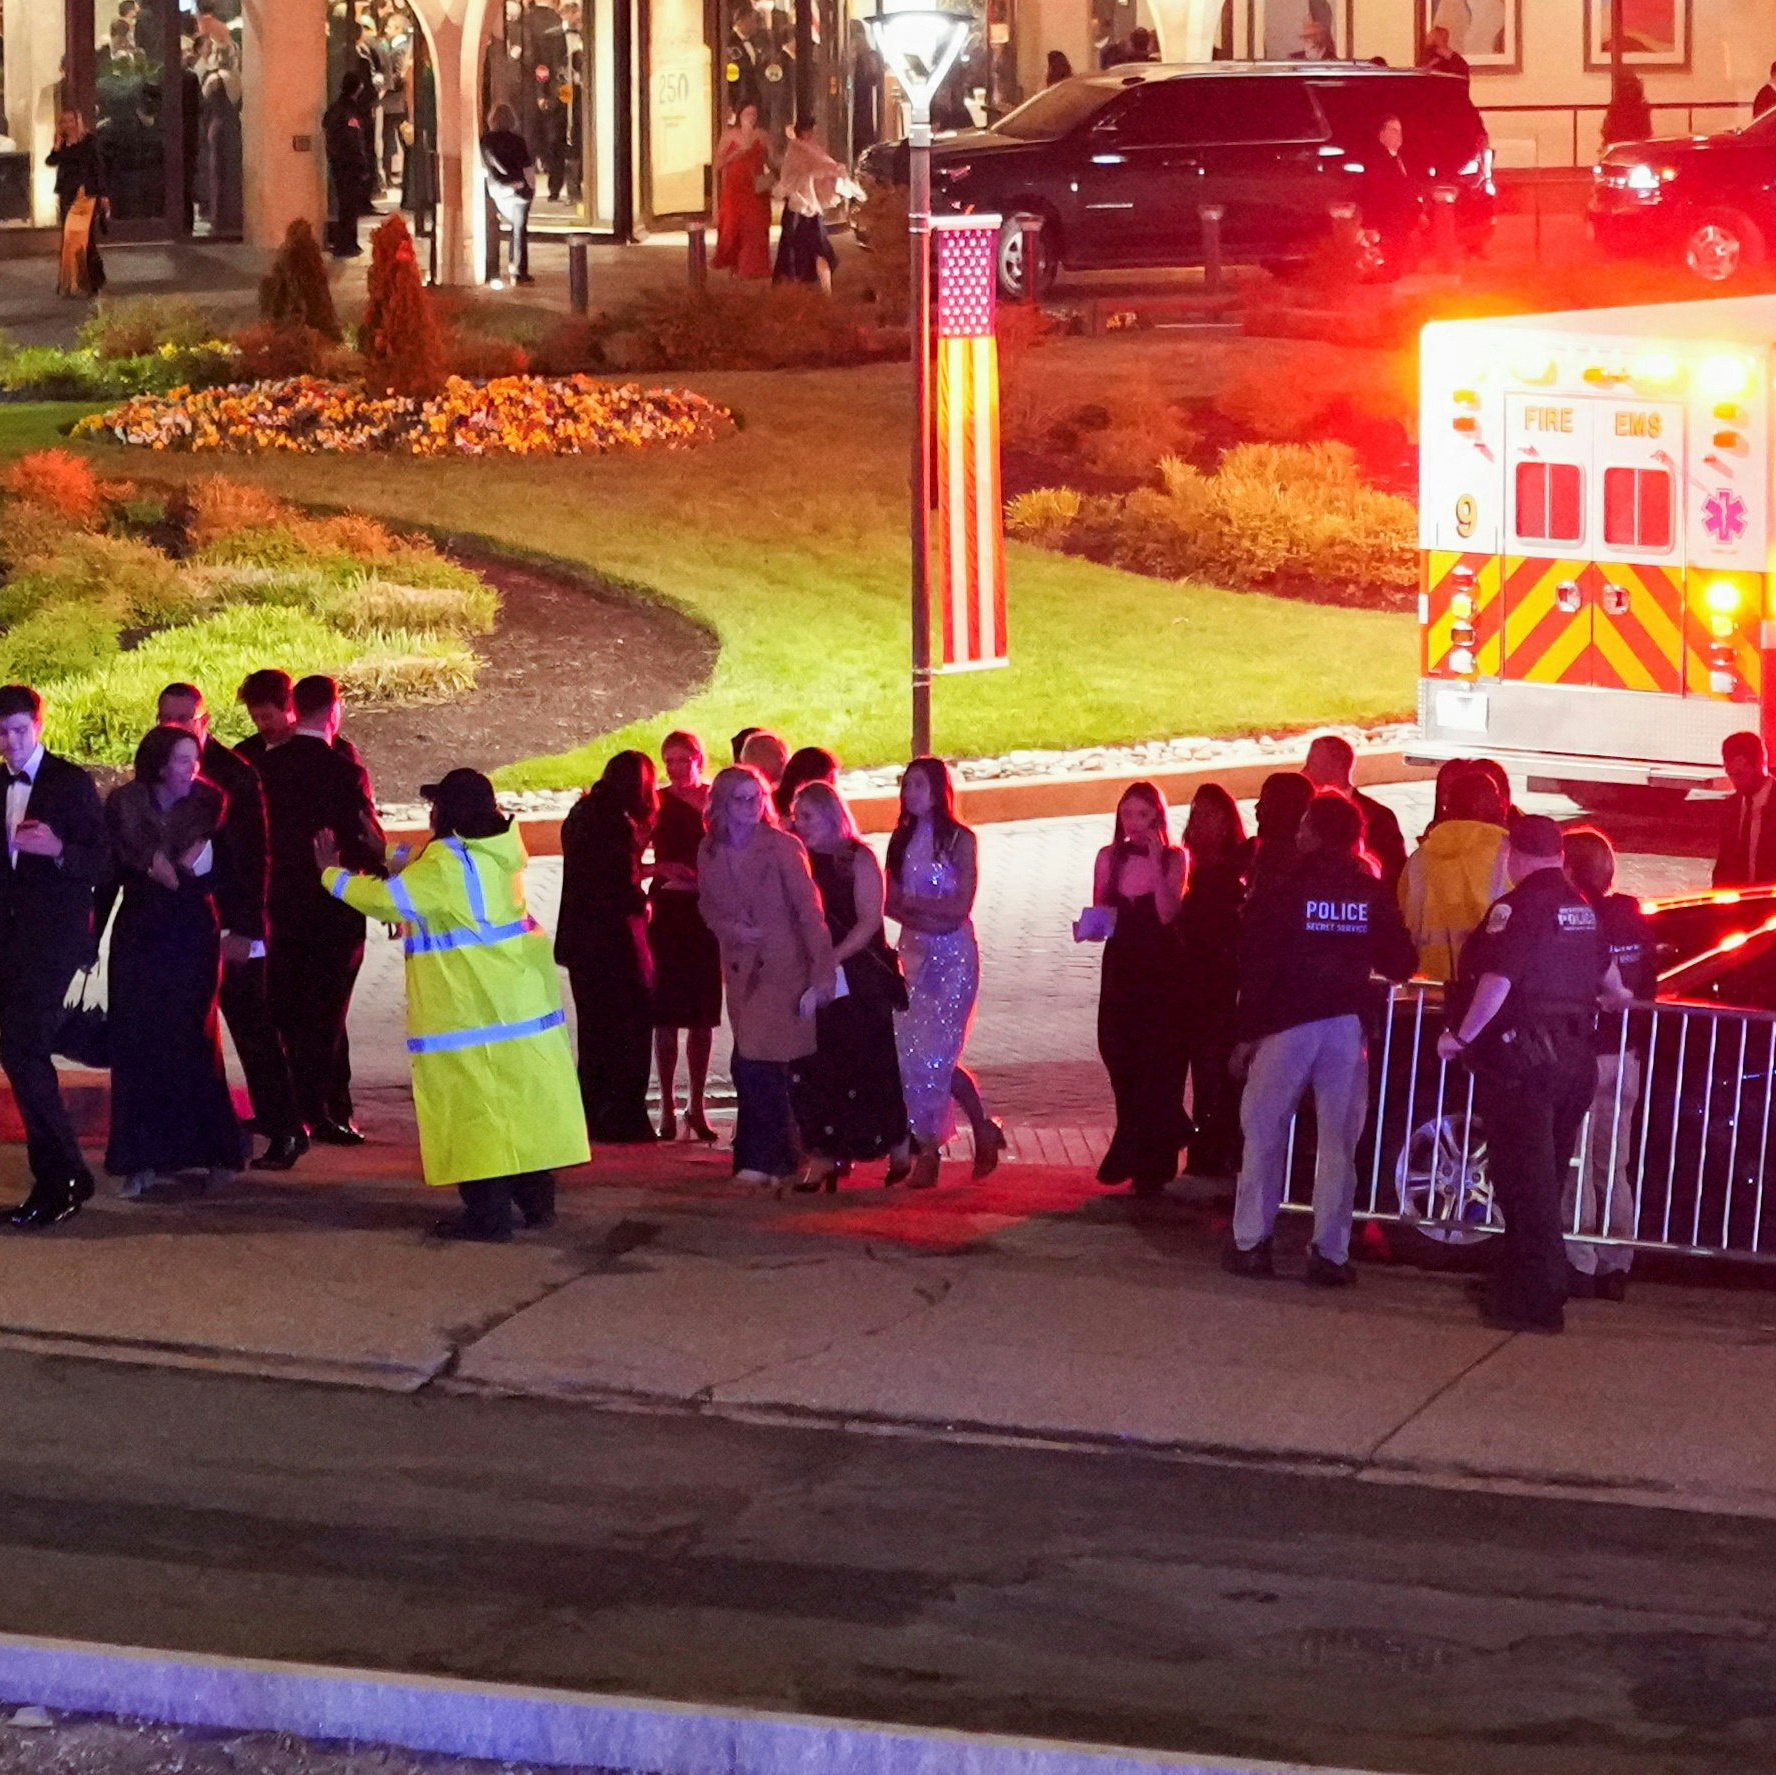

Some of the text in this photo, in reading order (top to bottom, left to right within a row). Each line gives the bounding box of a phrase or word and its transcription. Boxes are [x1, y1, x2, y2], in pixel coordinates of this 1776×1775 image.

[1525, 406, 1663, 439] FIRE EMS
[1455, 494, 1478, 538] 9
[1306, 900, 1368, 921] POLICE
